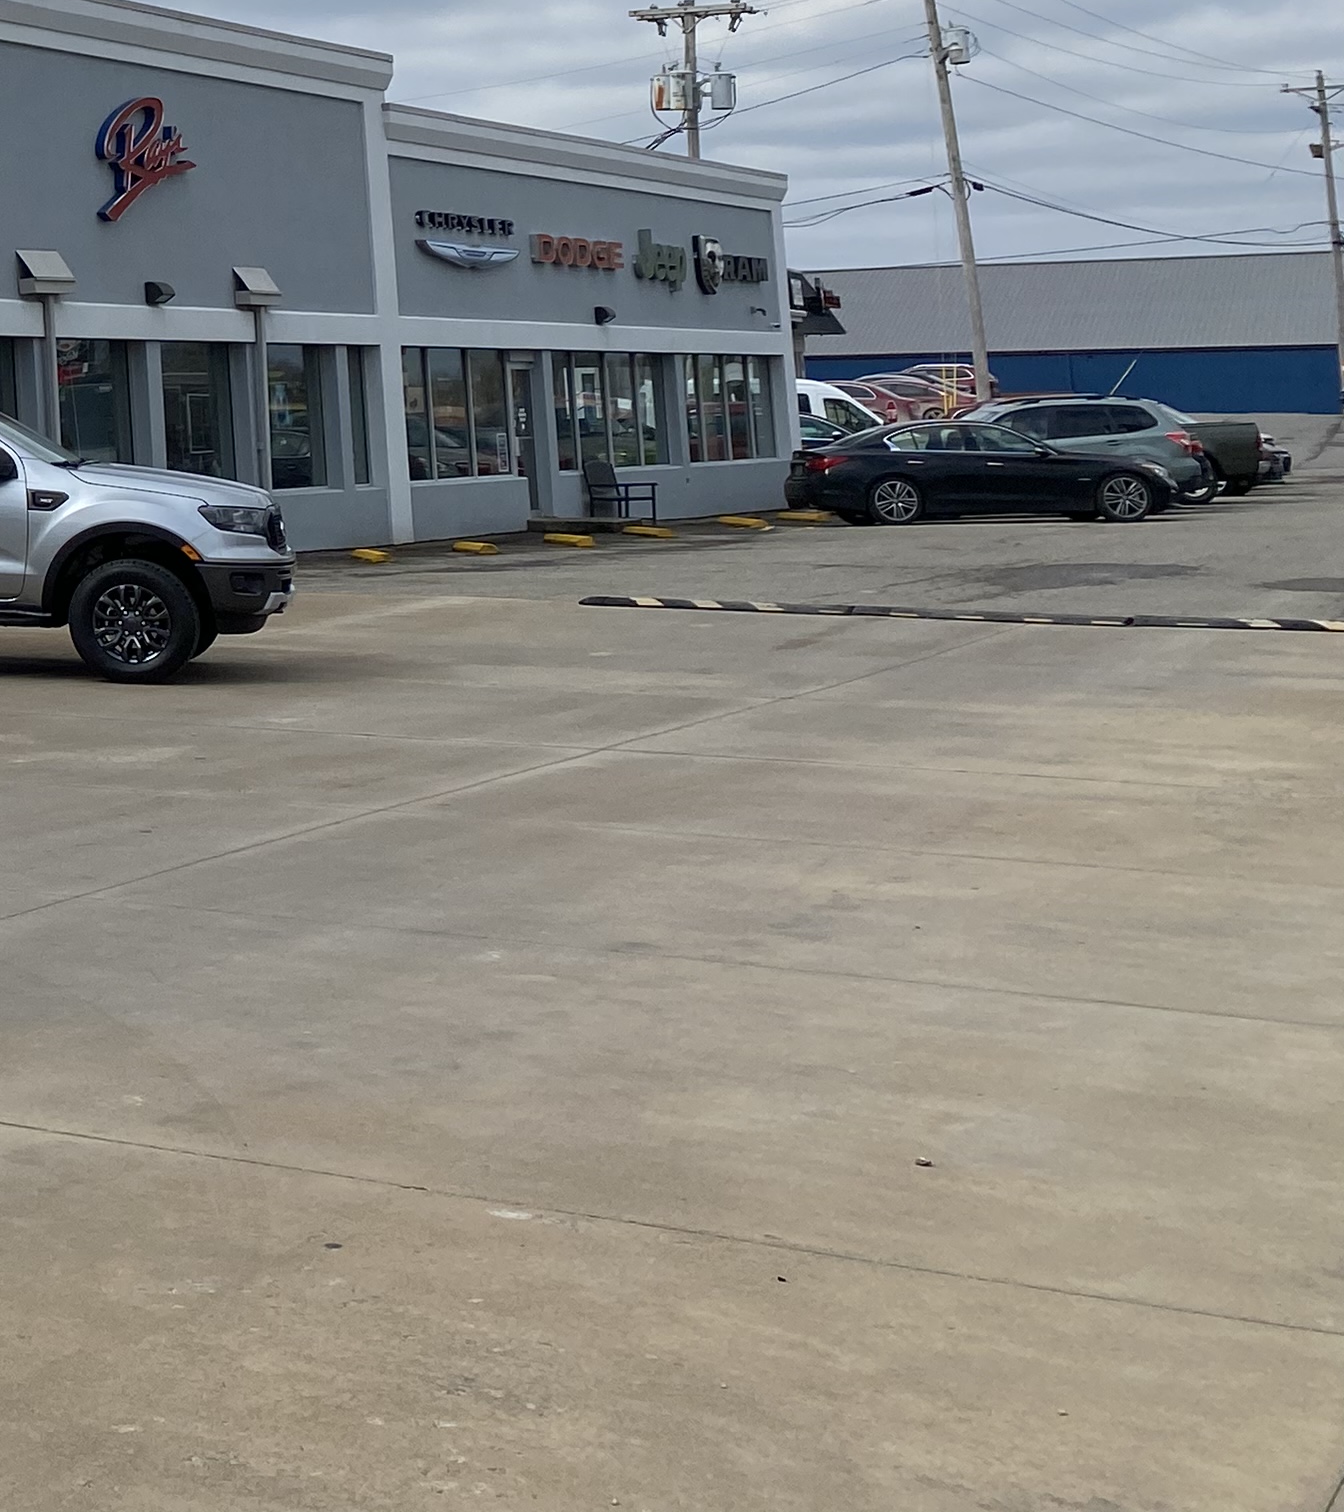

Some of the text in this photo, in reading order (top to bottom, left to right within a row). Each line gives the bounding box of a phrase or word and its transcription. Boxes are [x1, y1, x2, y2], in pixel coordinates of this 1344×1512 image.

[415, 210, 514, 236] CHRYSLER
[529, 233, 625, 269] DODGE
[633, 228, 687, 293] Jeep
[722, 254, 769, 282] RAM
